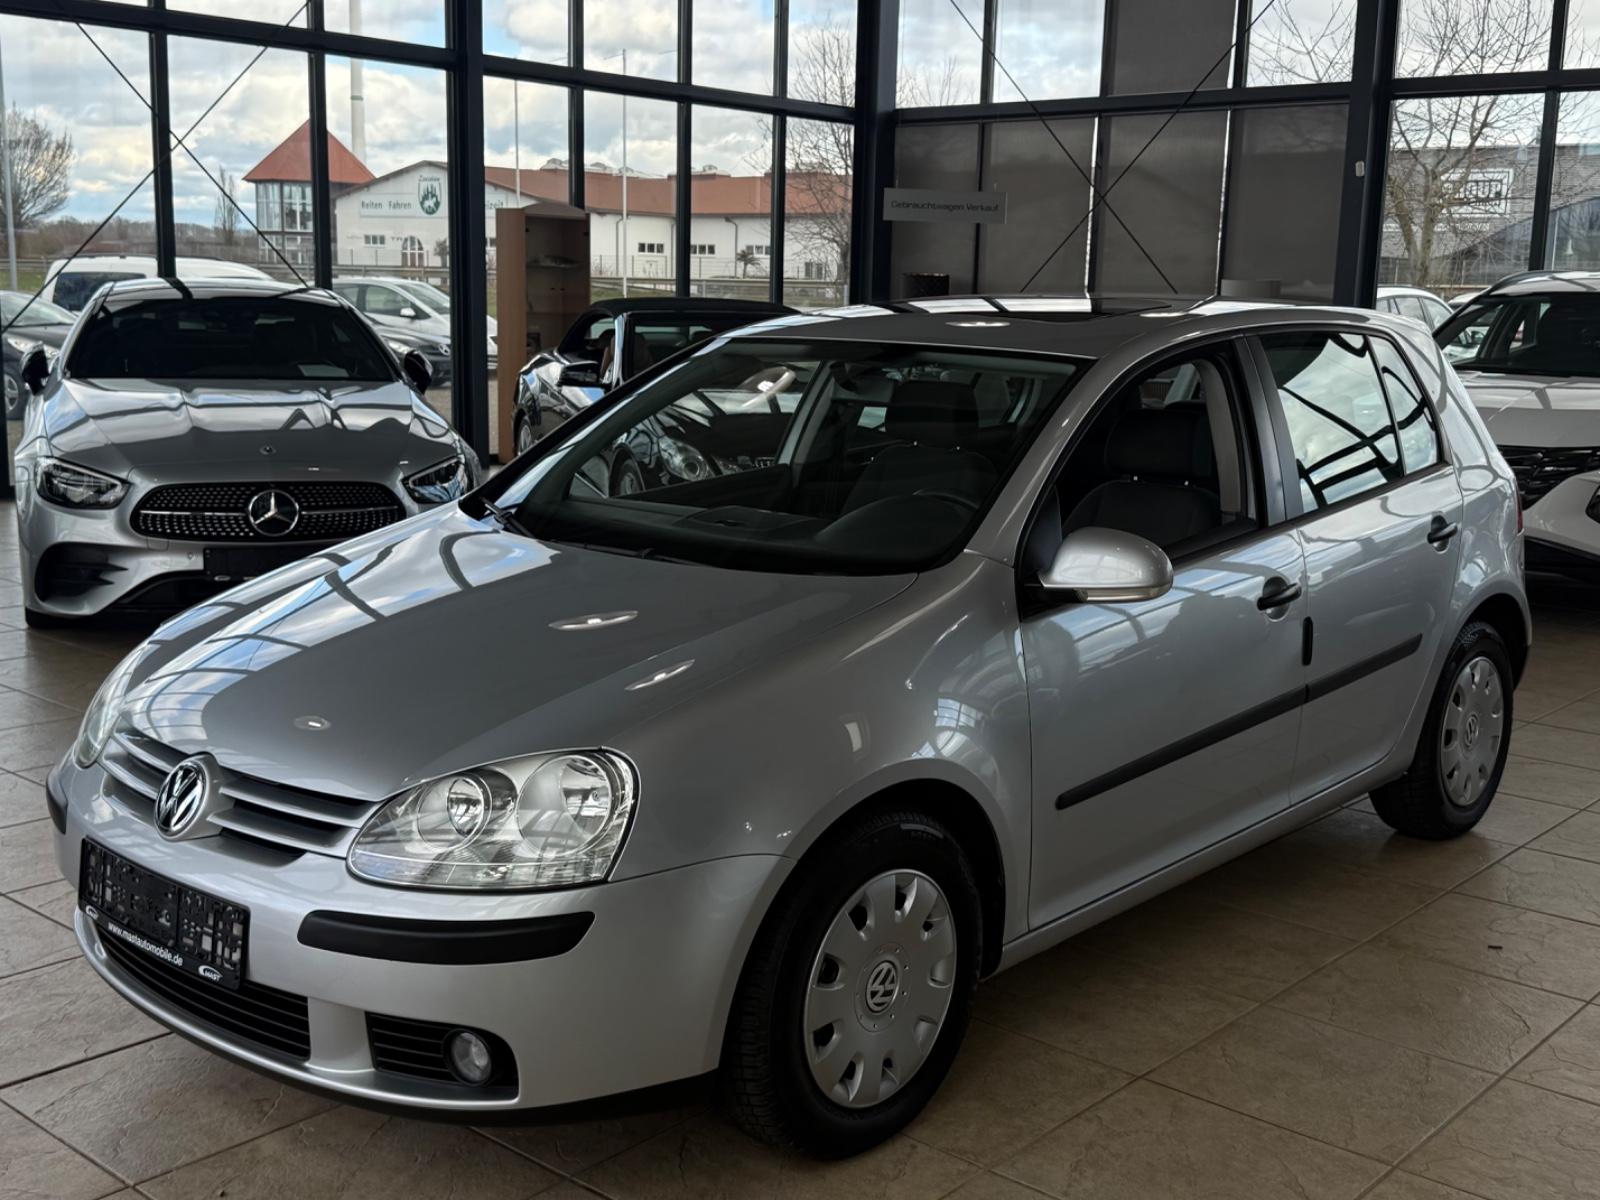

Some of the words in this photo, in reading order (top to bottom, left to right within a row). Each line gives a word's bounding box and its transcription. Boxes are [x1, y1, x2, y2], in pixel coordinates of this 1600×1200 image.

[361, 200, 383, 209] Reiten
[388, 200, 412, 209] Fahren
[891, 200, 964, 212] Gebrauchtwagen
[966, 203, 999, 212] Verkauf
[107, 922, 184, 967] www.mastautomobile.de
